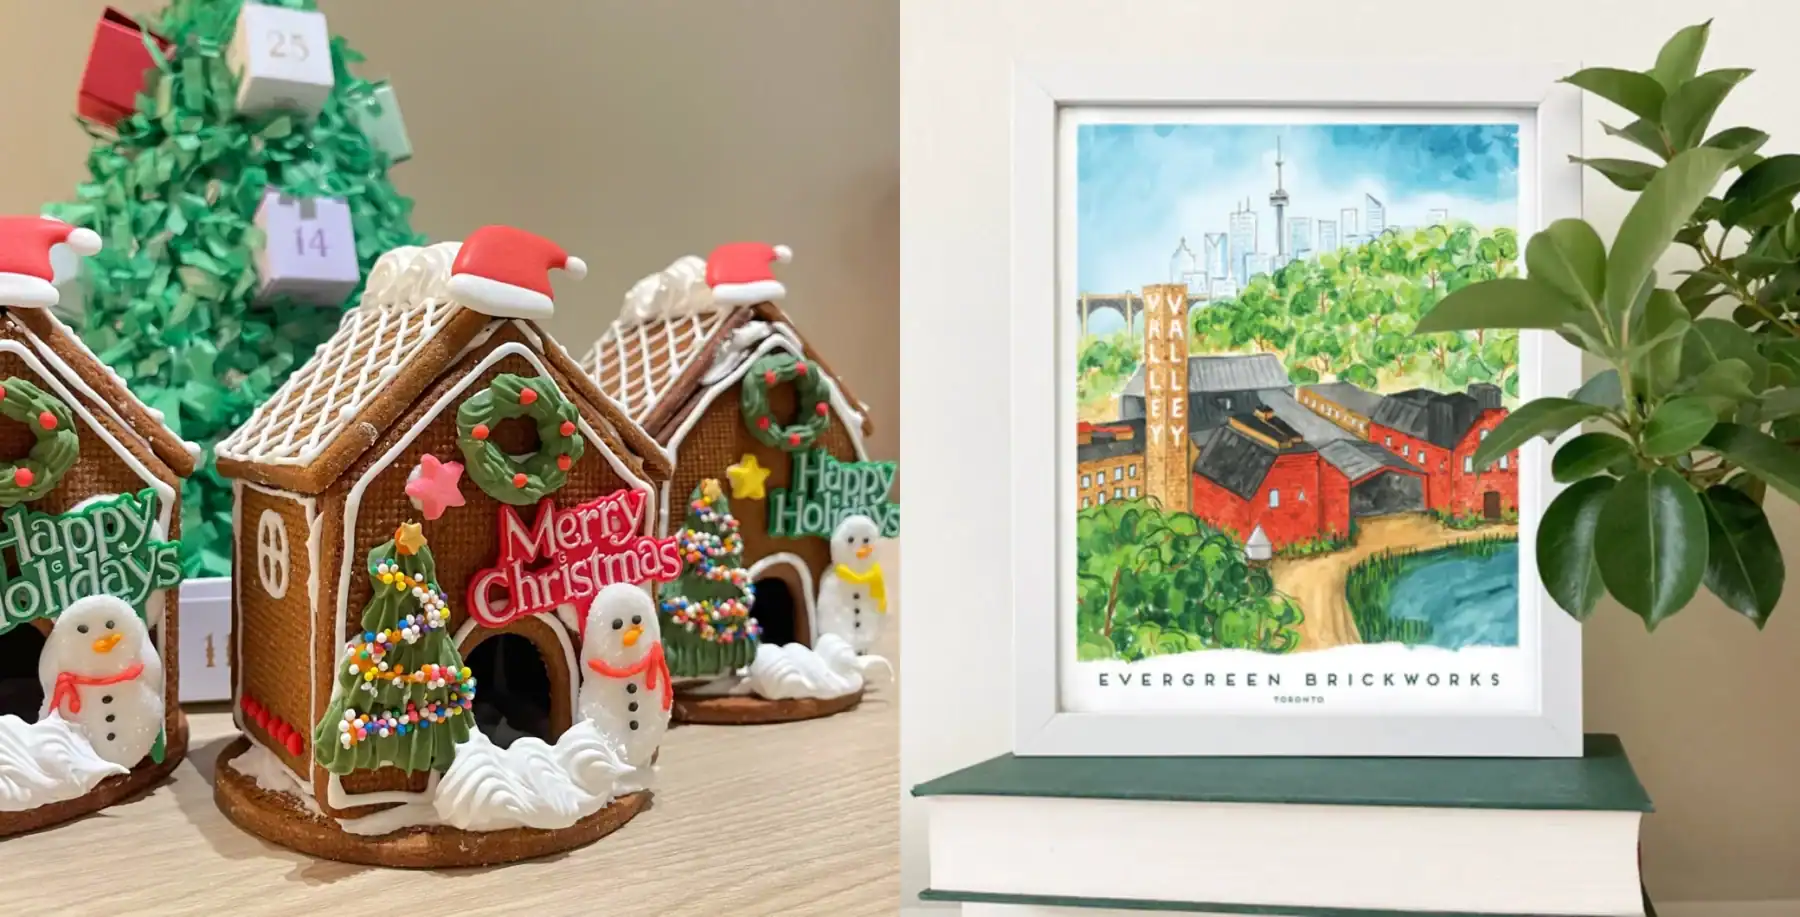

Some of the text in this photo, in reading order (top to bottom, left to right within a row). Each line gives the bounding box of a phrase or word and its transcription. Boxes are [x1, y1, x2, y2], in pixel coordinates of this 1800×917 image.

[266, 29, 310, 61] 25
[294, 226, 334, 257] 14
[1167, 294, 1184, 447] VALLEY
[797, 451, 897, 507] Happy
[505, 491, 646, 562] Merry
[0, 545, 181, 629] olidays
[474, 539, 682, 624] Christmas
[1098, 672, 1501, 687] EVERGREEN BRICKWORKS
[1273, 695, 1325, 704] TORONTO
